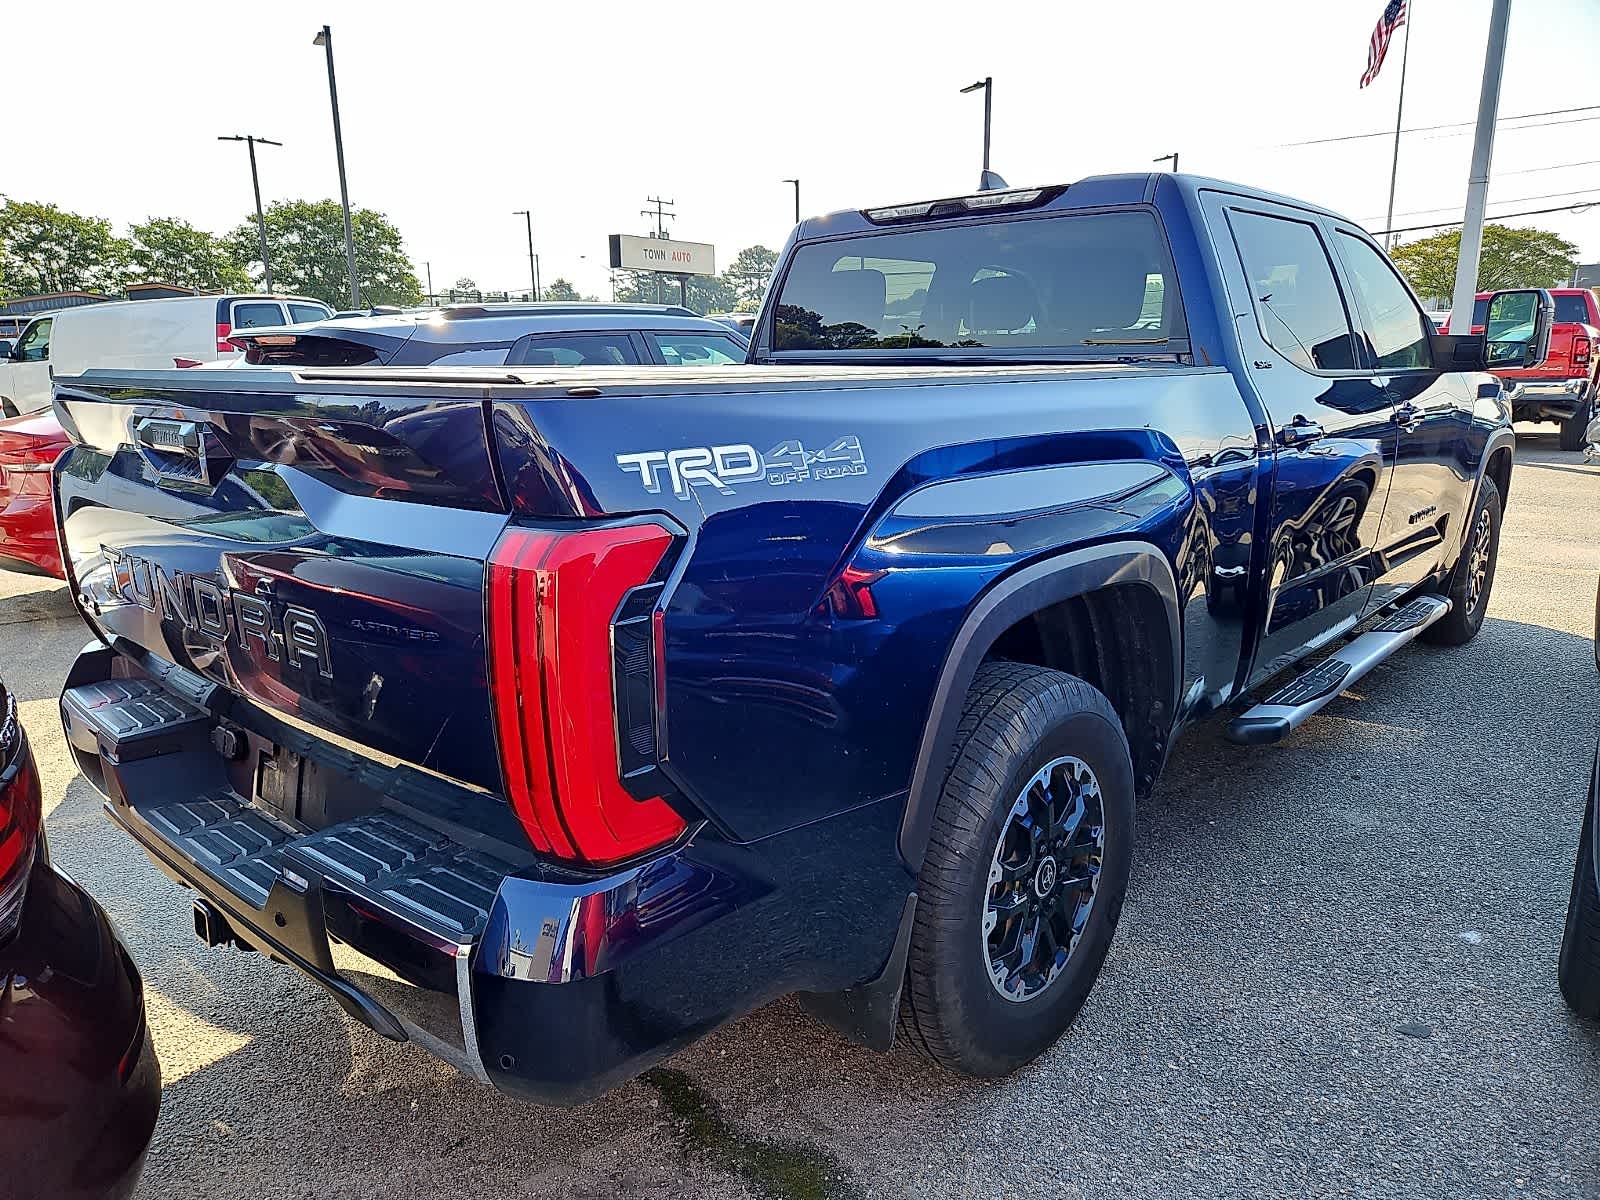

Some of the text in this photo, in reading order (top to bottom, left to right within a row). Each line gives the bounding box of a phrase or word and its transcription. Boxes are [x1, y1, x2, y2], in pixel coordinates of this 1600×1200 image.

[643, 248, 692, 264] TOWN AUTO
[616, 444, 766, 501] TRD
[766, 464, 868, 487] OFF ROAD
[99, 543, 334, 681] TUNDRA
